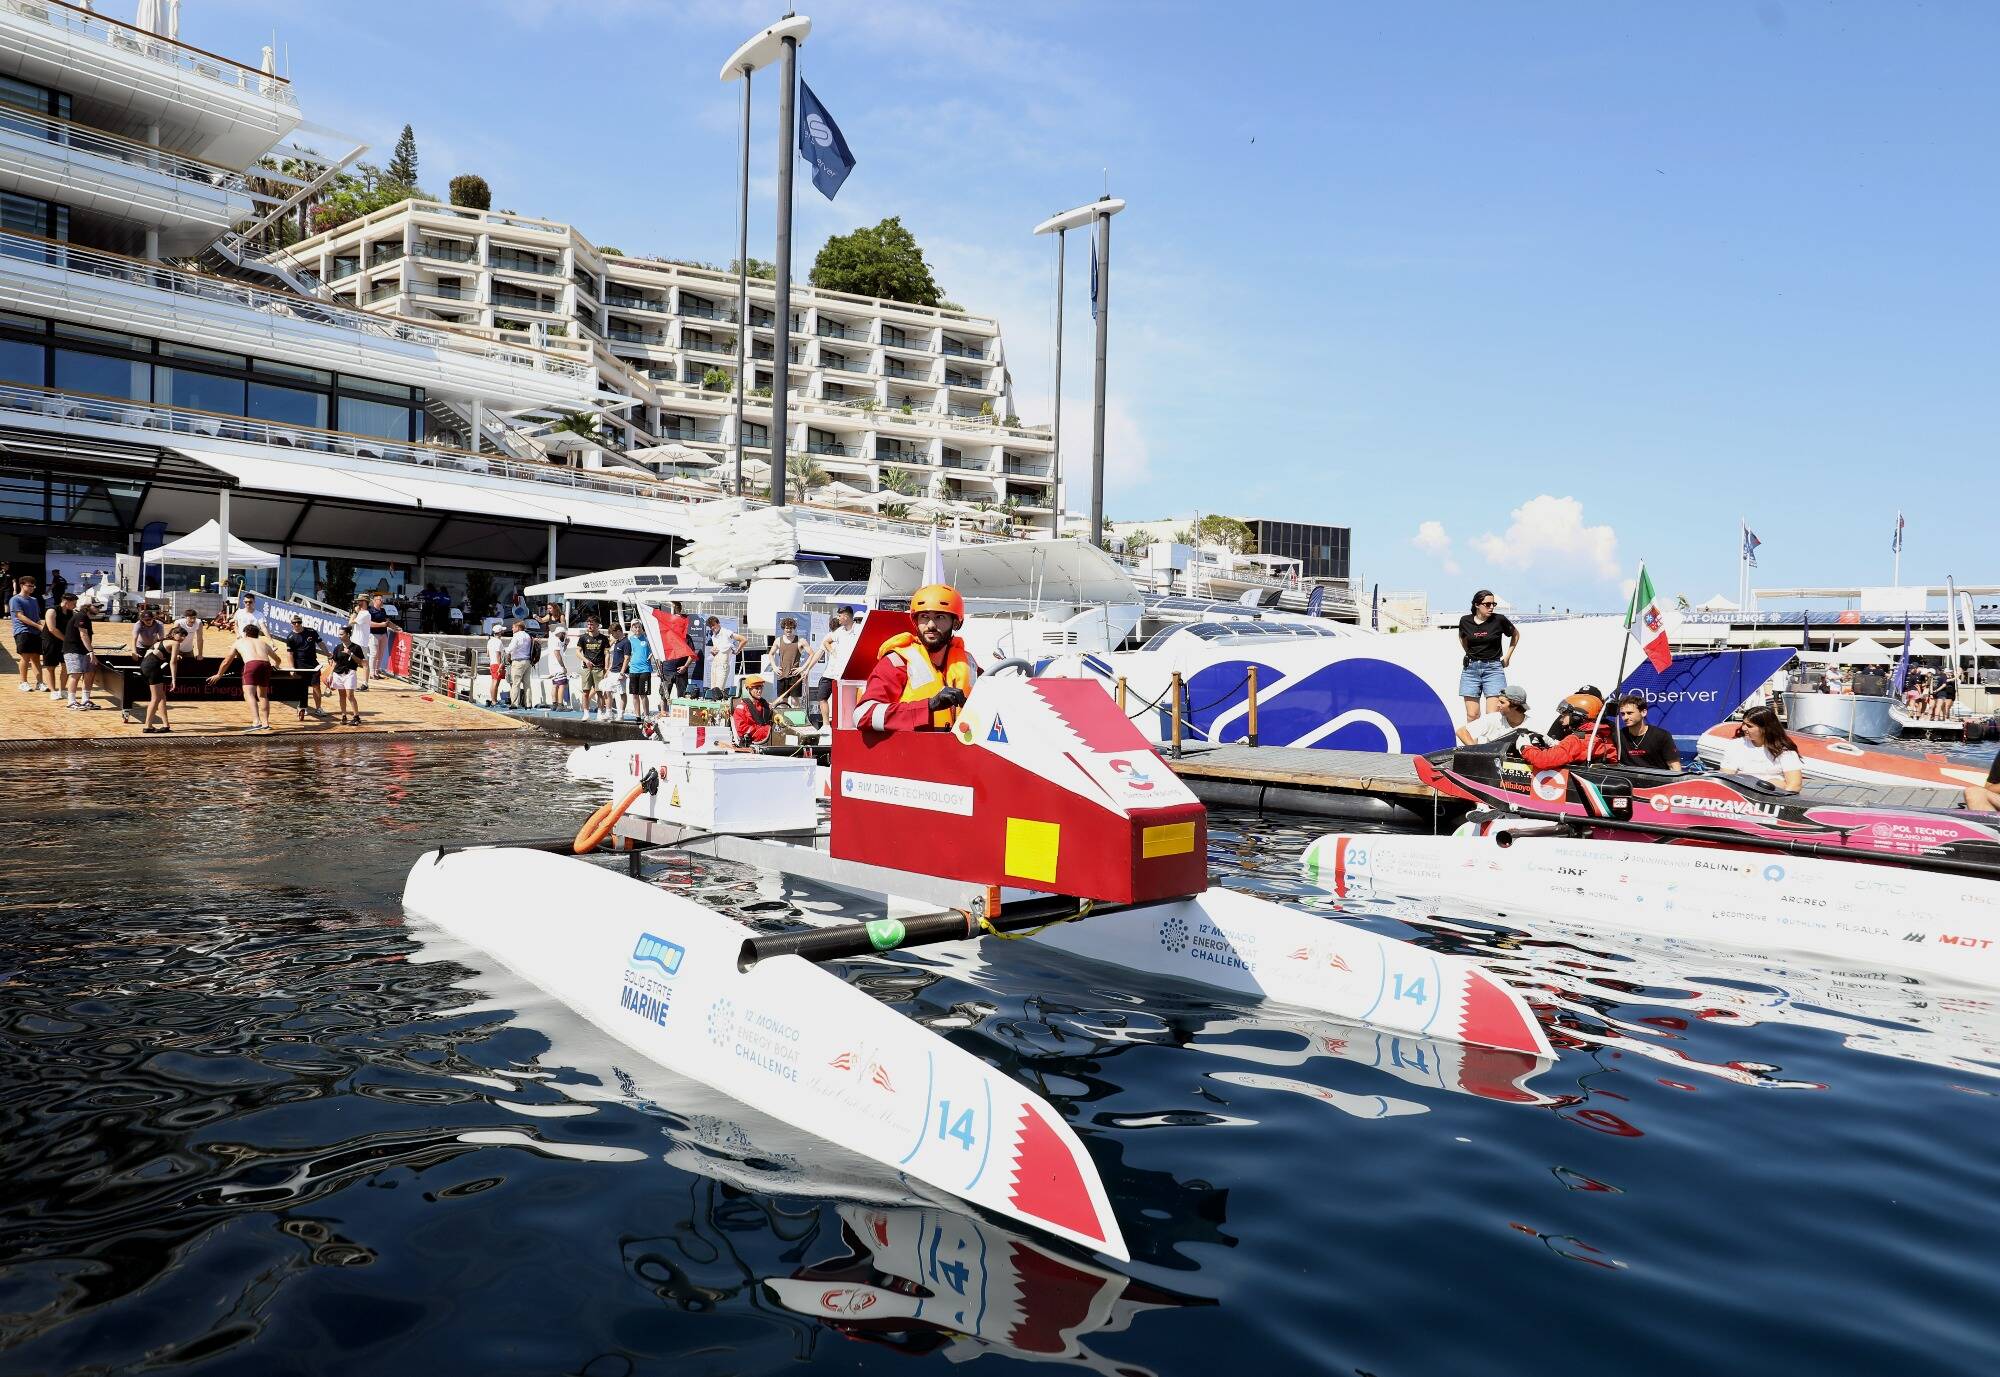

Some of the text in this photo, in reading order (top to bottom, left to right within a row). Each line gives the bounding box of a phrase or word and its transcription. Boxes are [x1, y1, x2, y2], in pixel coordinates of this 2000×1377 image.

[323, 619, 342, 637] BOAT
[1702, 612, 1766, 623] CHALLENGE
[1628, 688, 1718, 703] Observer
[858, 781, 965, 806] RIM DRIVE TECHNOLOGY
[1670, 794, 1780, 818] CHIARAVALLI
[1703, 810, 1742, 820] GROUP
[1892, 824, 1959, 838] POLTECNICO
[1347, 849, 1367, 866] 23
[1192, 935, 1230, 952] ENERGY
[1211, 926, 1256, 944] MONACO
[1191, 948, 1257, 972] CHALLENGE
[624, 969, 645, 988] SOLID
[1393, 973, 1427, 1006] 14
[620, 985, 669, 1027] MARINE
[756, 1015, 800, 1042] MONACO
[737, 1025, 801, 1065] ENERGY BOAT
[735, 1043, 798, 1083] CHALLENGE
[939, 1100, 976, 1151] 14
